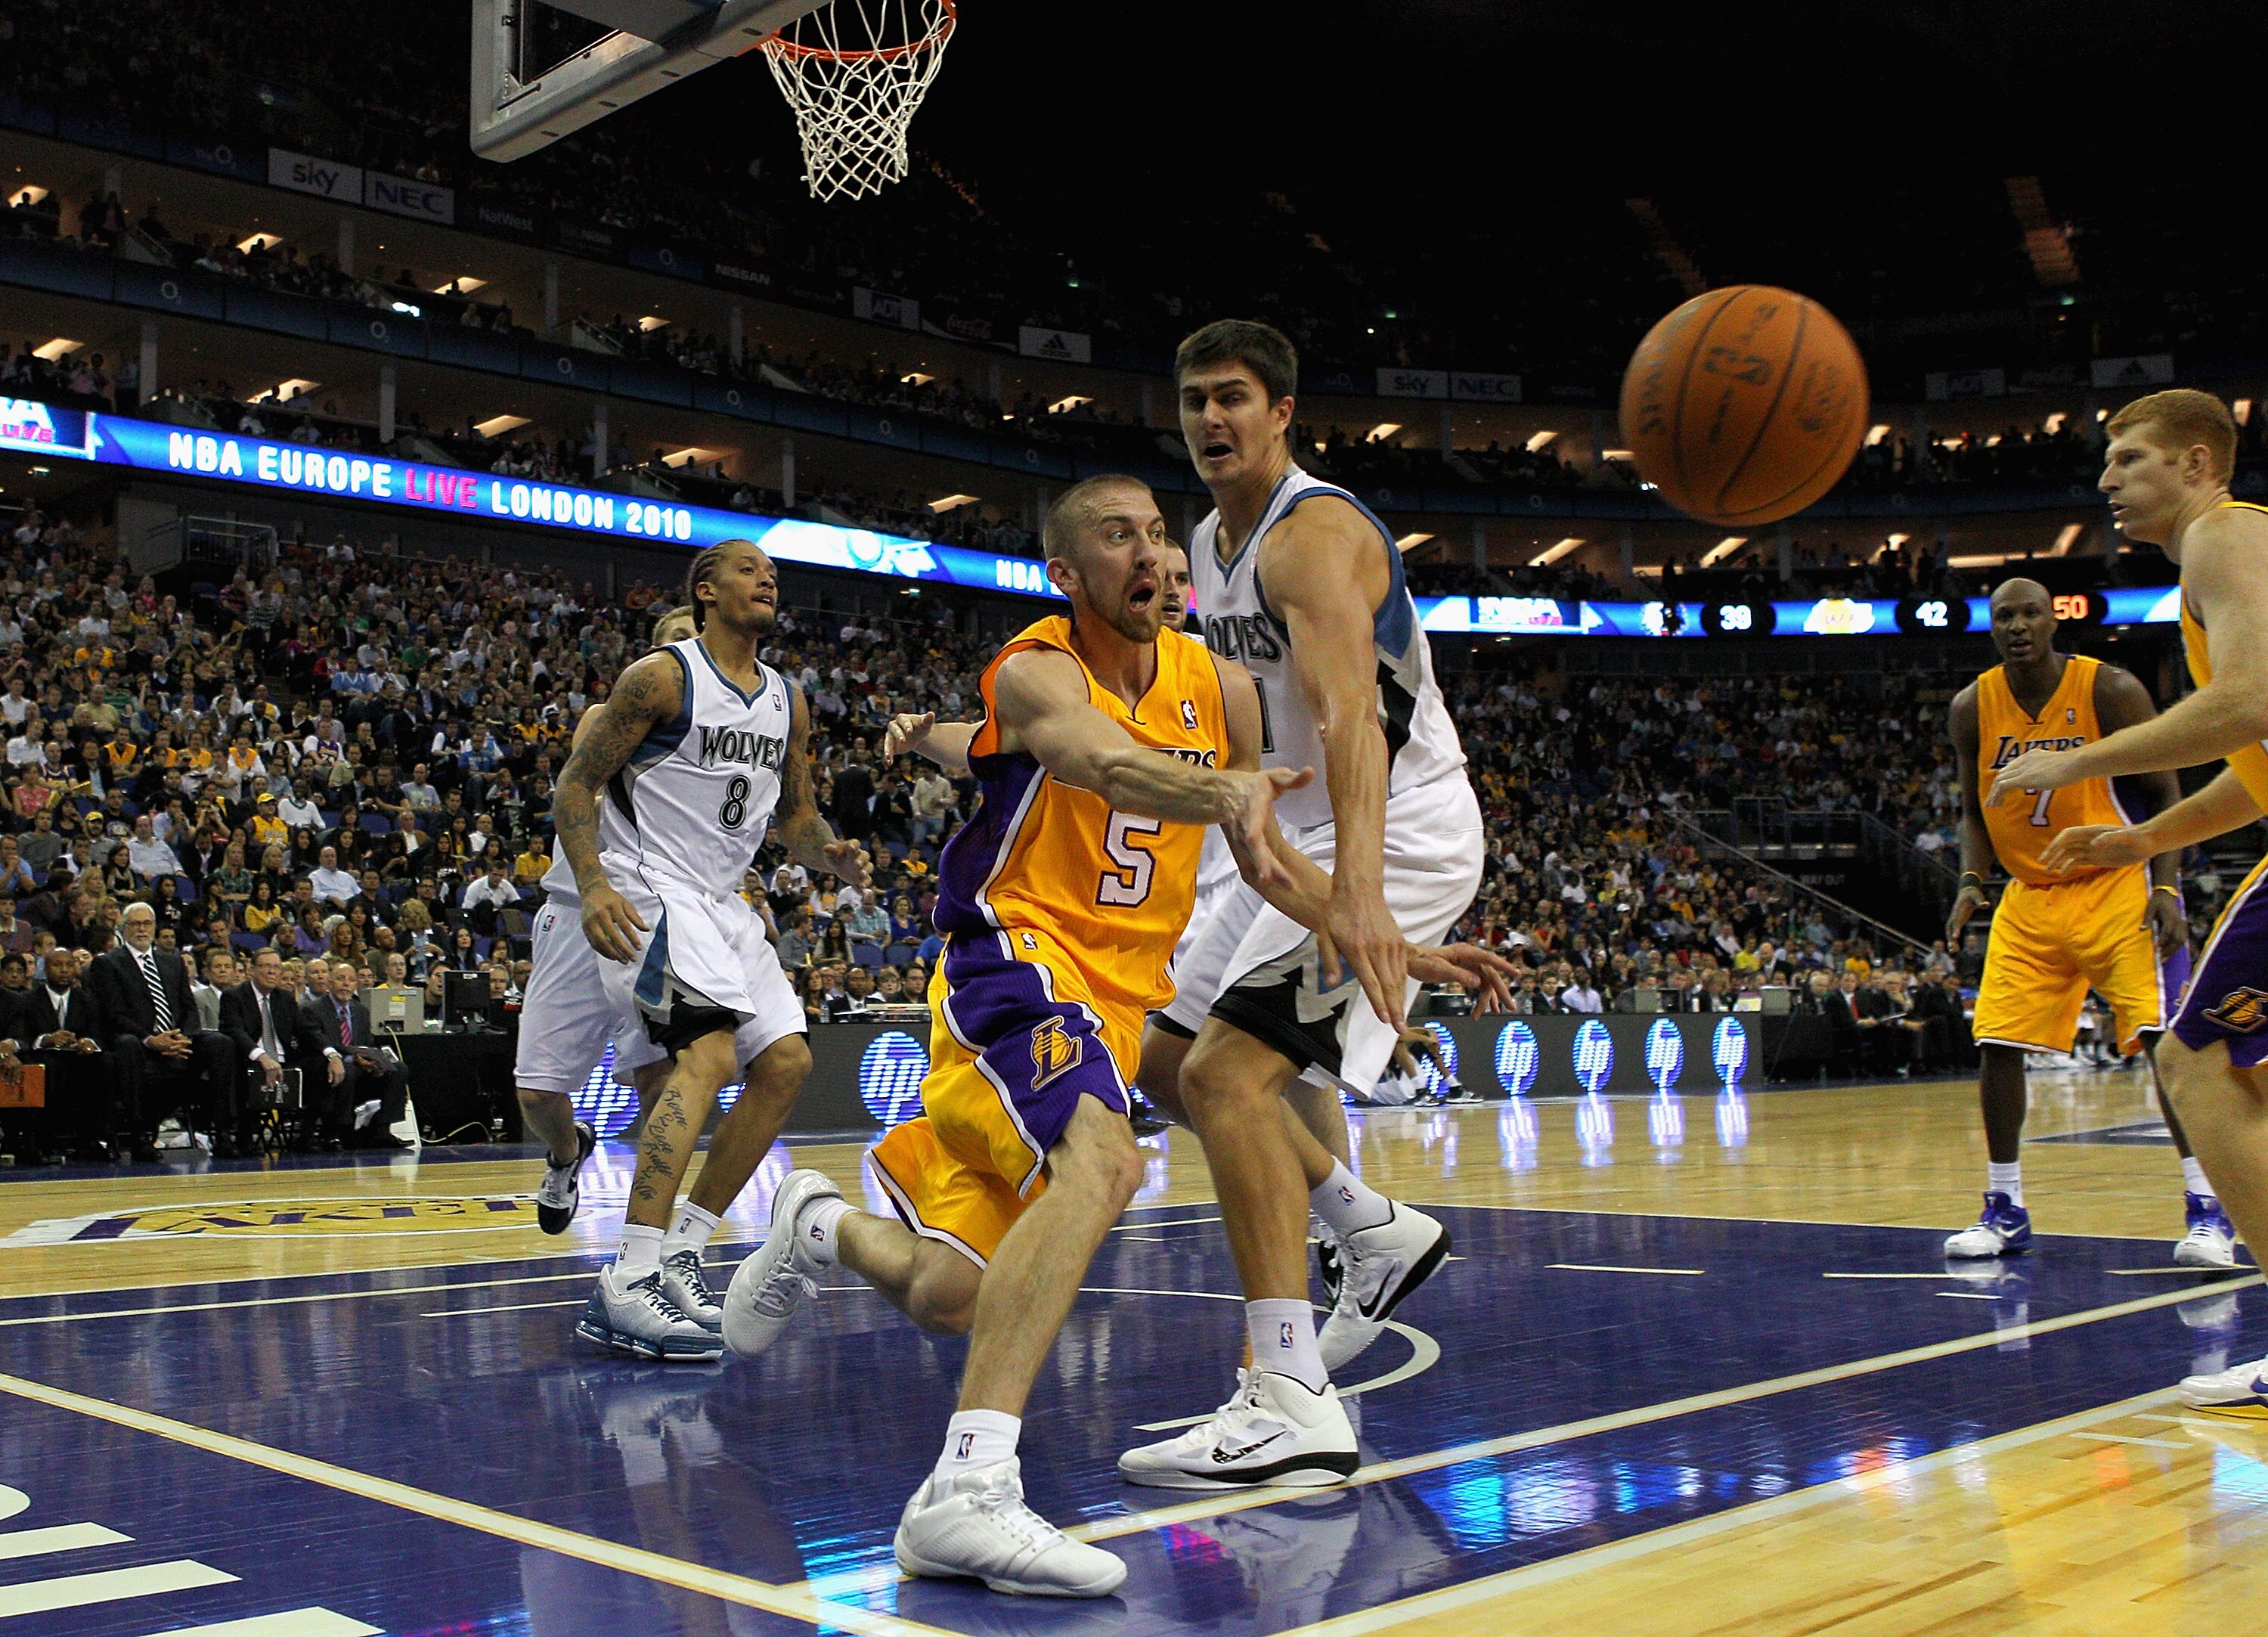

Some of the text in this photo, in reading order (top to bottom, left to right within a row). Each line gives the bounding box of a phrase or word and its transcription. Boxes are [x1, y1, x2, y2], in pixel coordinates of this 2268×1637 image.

[293, 161, 339, 194] sky
[374, 180, 444, 214] NEC
[714, 263, 771, 286] NISSAN
[169, 432, 692, 541] NBA EUROPE LIVE LONDON 2010
[996, 559, 1043, 593] NBA
[1916, 601, 1948, 627] 42
[2053, 595, 2088, 620] 50
[698, 725, 785, 775] WOLVES
[719, 774, 752, 830] 8
[2025, 788, 2055, 827] 7
[1095, 809, 1163, 909] 5
